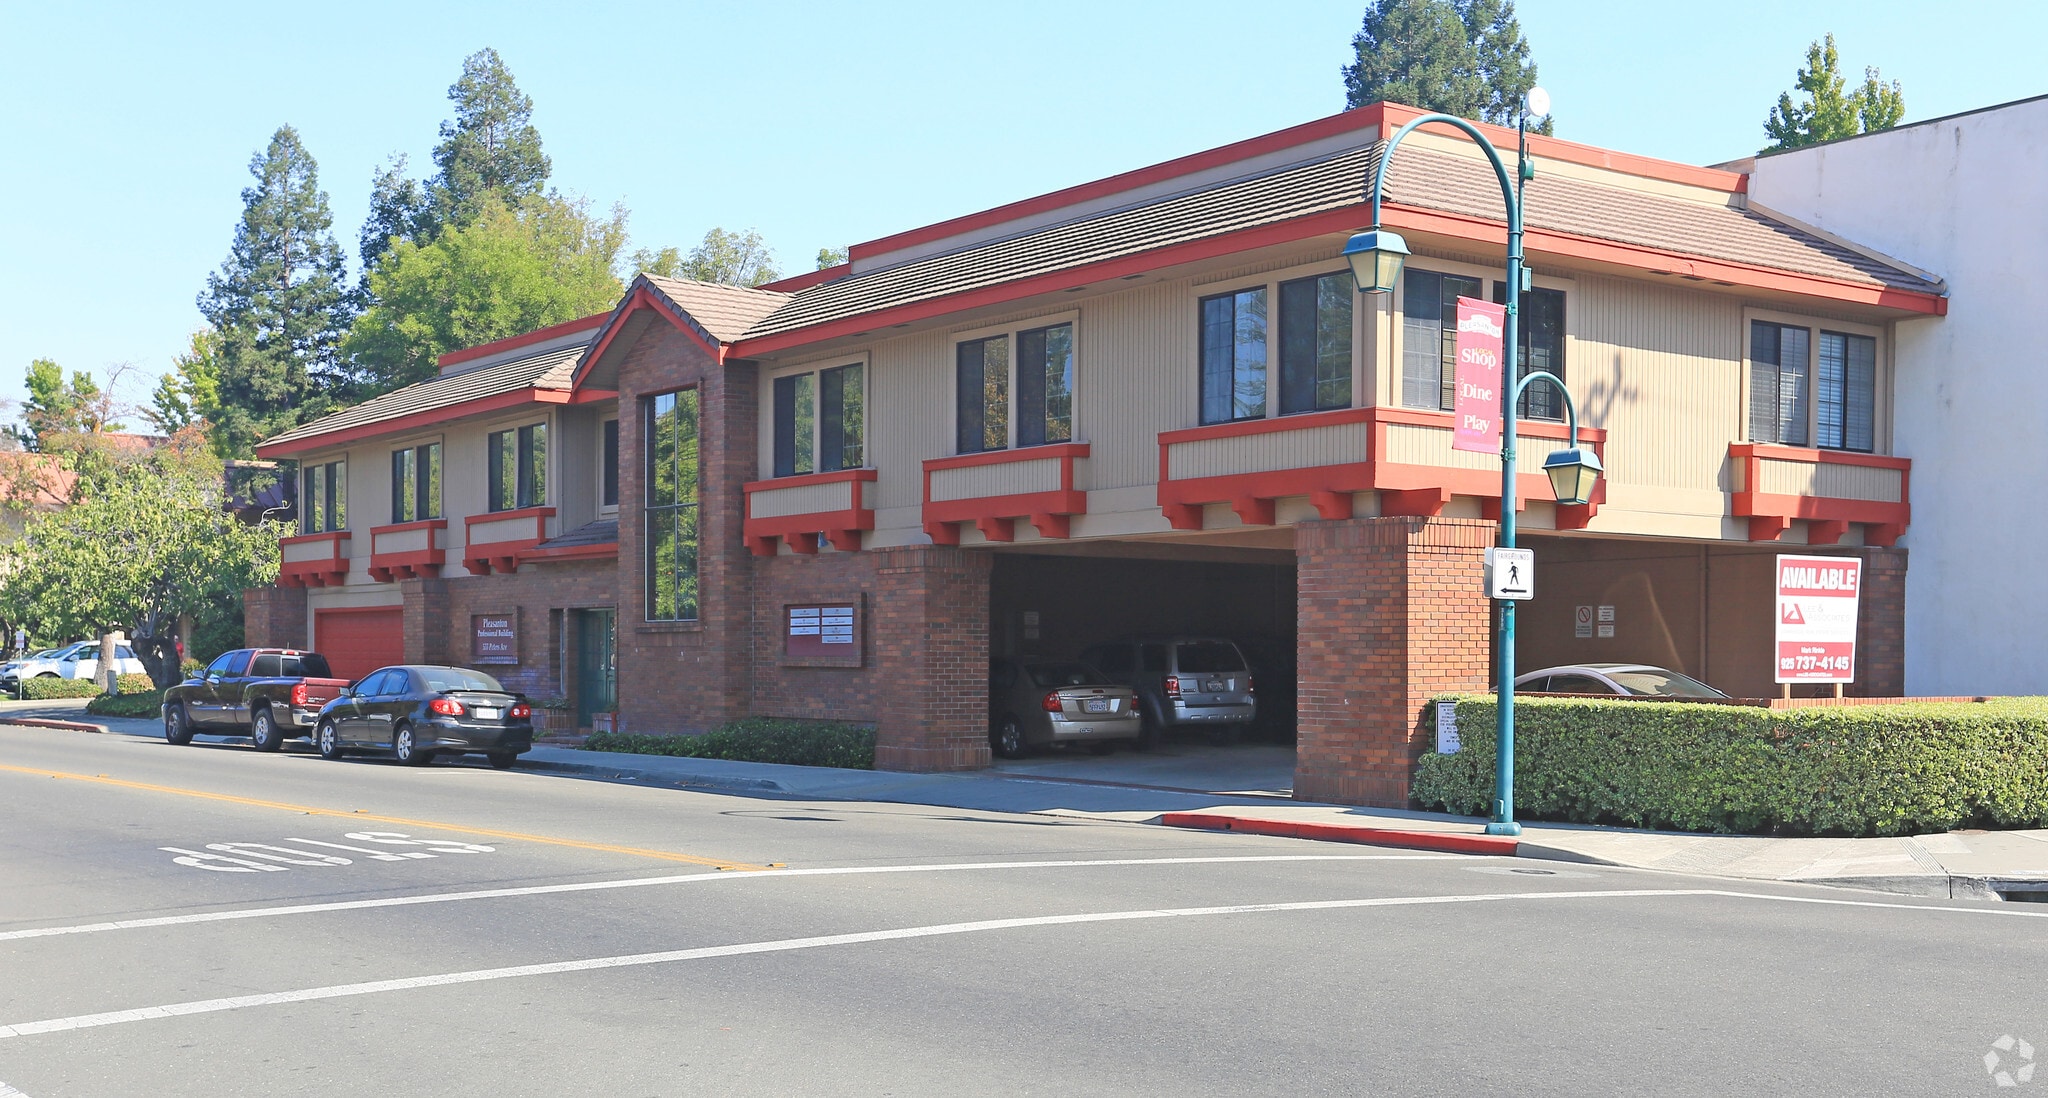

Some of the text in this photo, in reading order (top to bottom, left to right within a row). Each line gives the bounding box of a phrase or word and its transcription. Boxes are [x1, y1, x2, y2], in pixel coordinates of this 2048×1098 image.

[1461, 348, 1496, 370] Shop
[1463, 383, 1493, 401] Dine
[1463, 414, 1491, 434] Play
[1780, 566, 1856, 591] AVAILABLE
[483, 618, 507, 628] Pleasanton
[498, 630, 514, 638] Building
[1781, 656, 1850, 670] 925 737-4145
[157, 831, 496, 872] STOP
